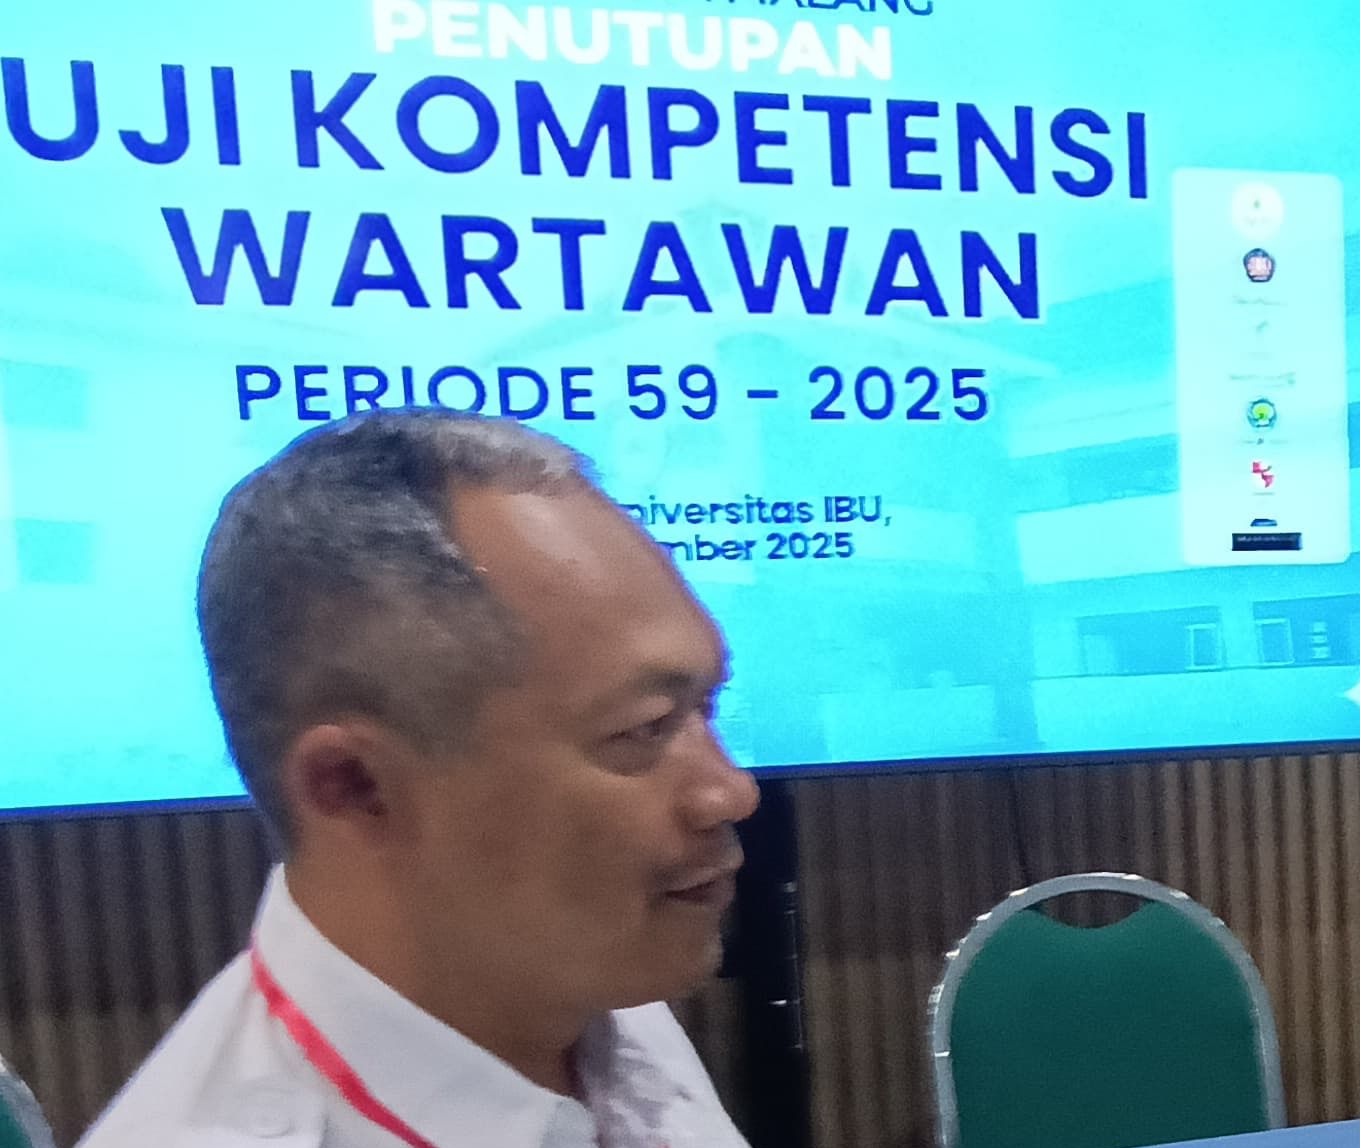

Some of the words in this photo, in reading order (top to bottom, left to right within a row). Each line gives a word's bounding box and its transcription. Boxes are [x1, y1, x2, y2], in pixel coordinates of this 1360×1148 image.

[373, 0, 893, 81] PENUTUPAN
[0, 56, 242, 166] UJI
[290, 69, 1148, 199] KOMPETENSI
[159, 206, 1042, 319] WARTAWAN
[235, 363, 598, 422] PERIODE
[626, 364, 719, 421] 59
[808, 365, 991, 423] 2025
[619, 494, 815, 525] niversitas
[823, 495, 893, 527] IBU,
[654, 534, 757, 561] mber
[765, 532, 856, 560] 2025
